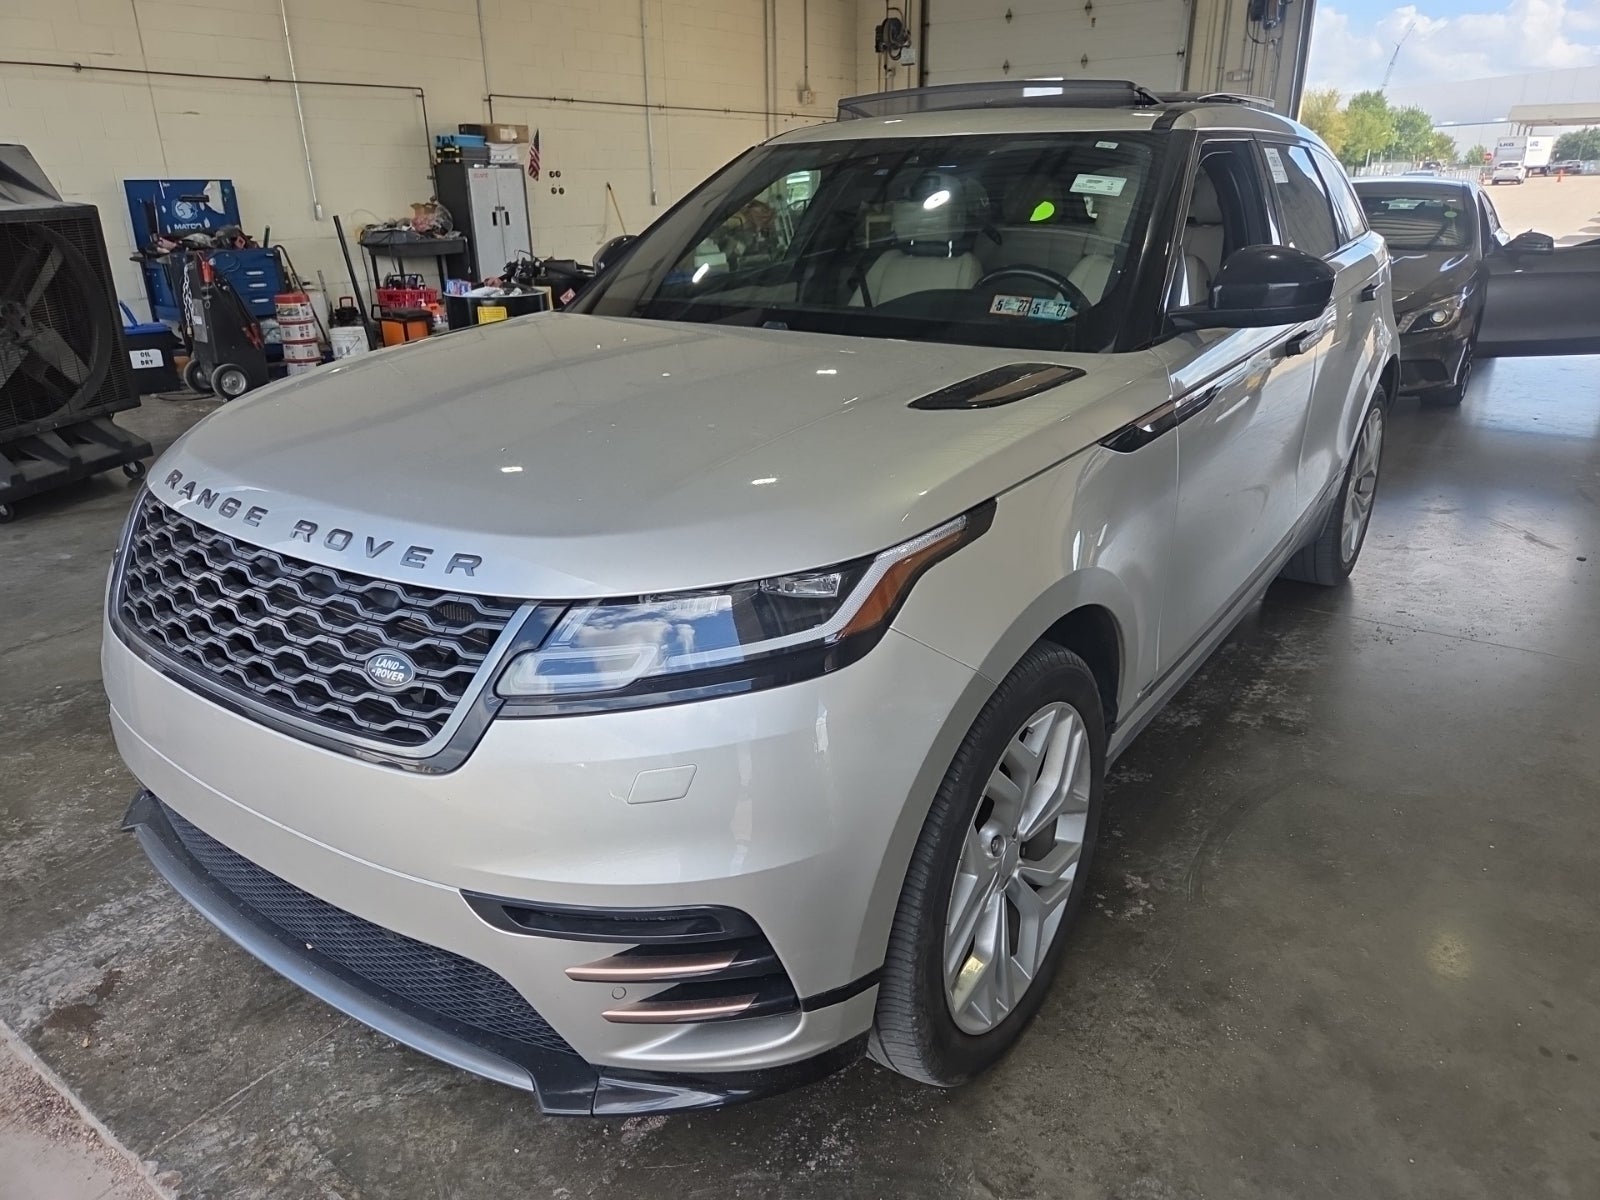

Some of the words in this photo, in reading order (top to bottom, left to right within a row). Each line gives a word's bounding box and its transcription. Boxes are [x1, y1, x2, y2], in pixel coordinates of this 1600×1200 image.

[1017, 300, 1029, 312] 27
[1056, 304, 1067, 317] 27
[164, 469, 268, 527] RANGE
[289, 519, 483, 577] ROVER
[375, 657, 400, 671] LAND
[374, 668, 405, 682] ROVER
